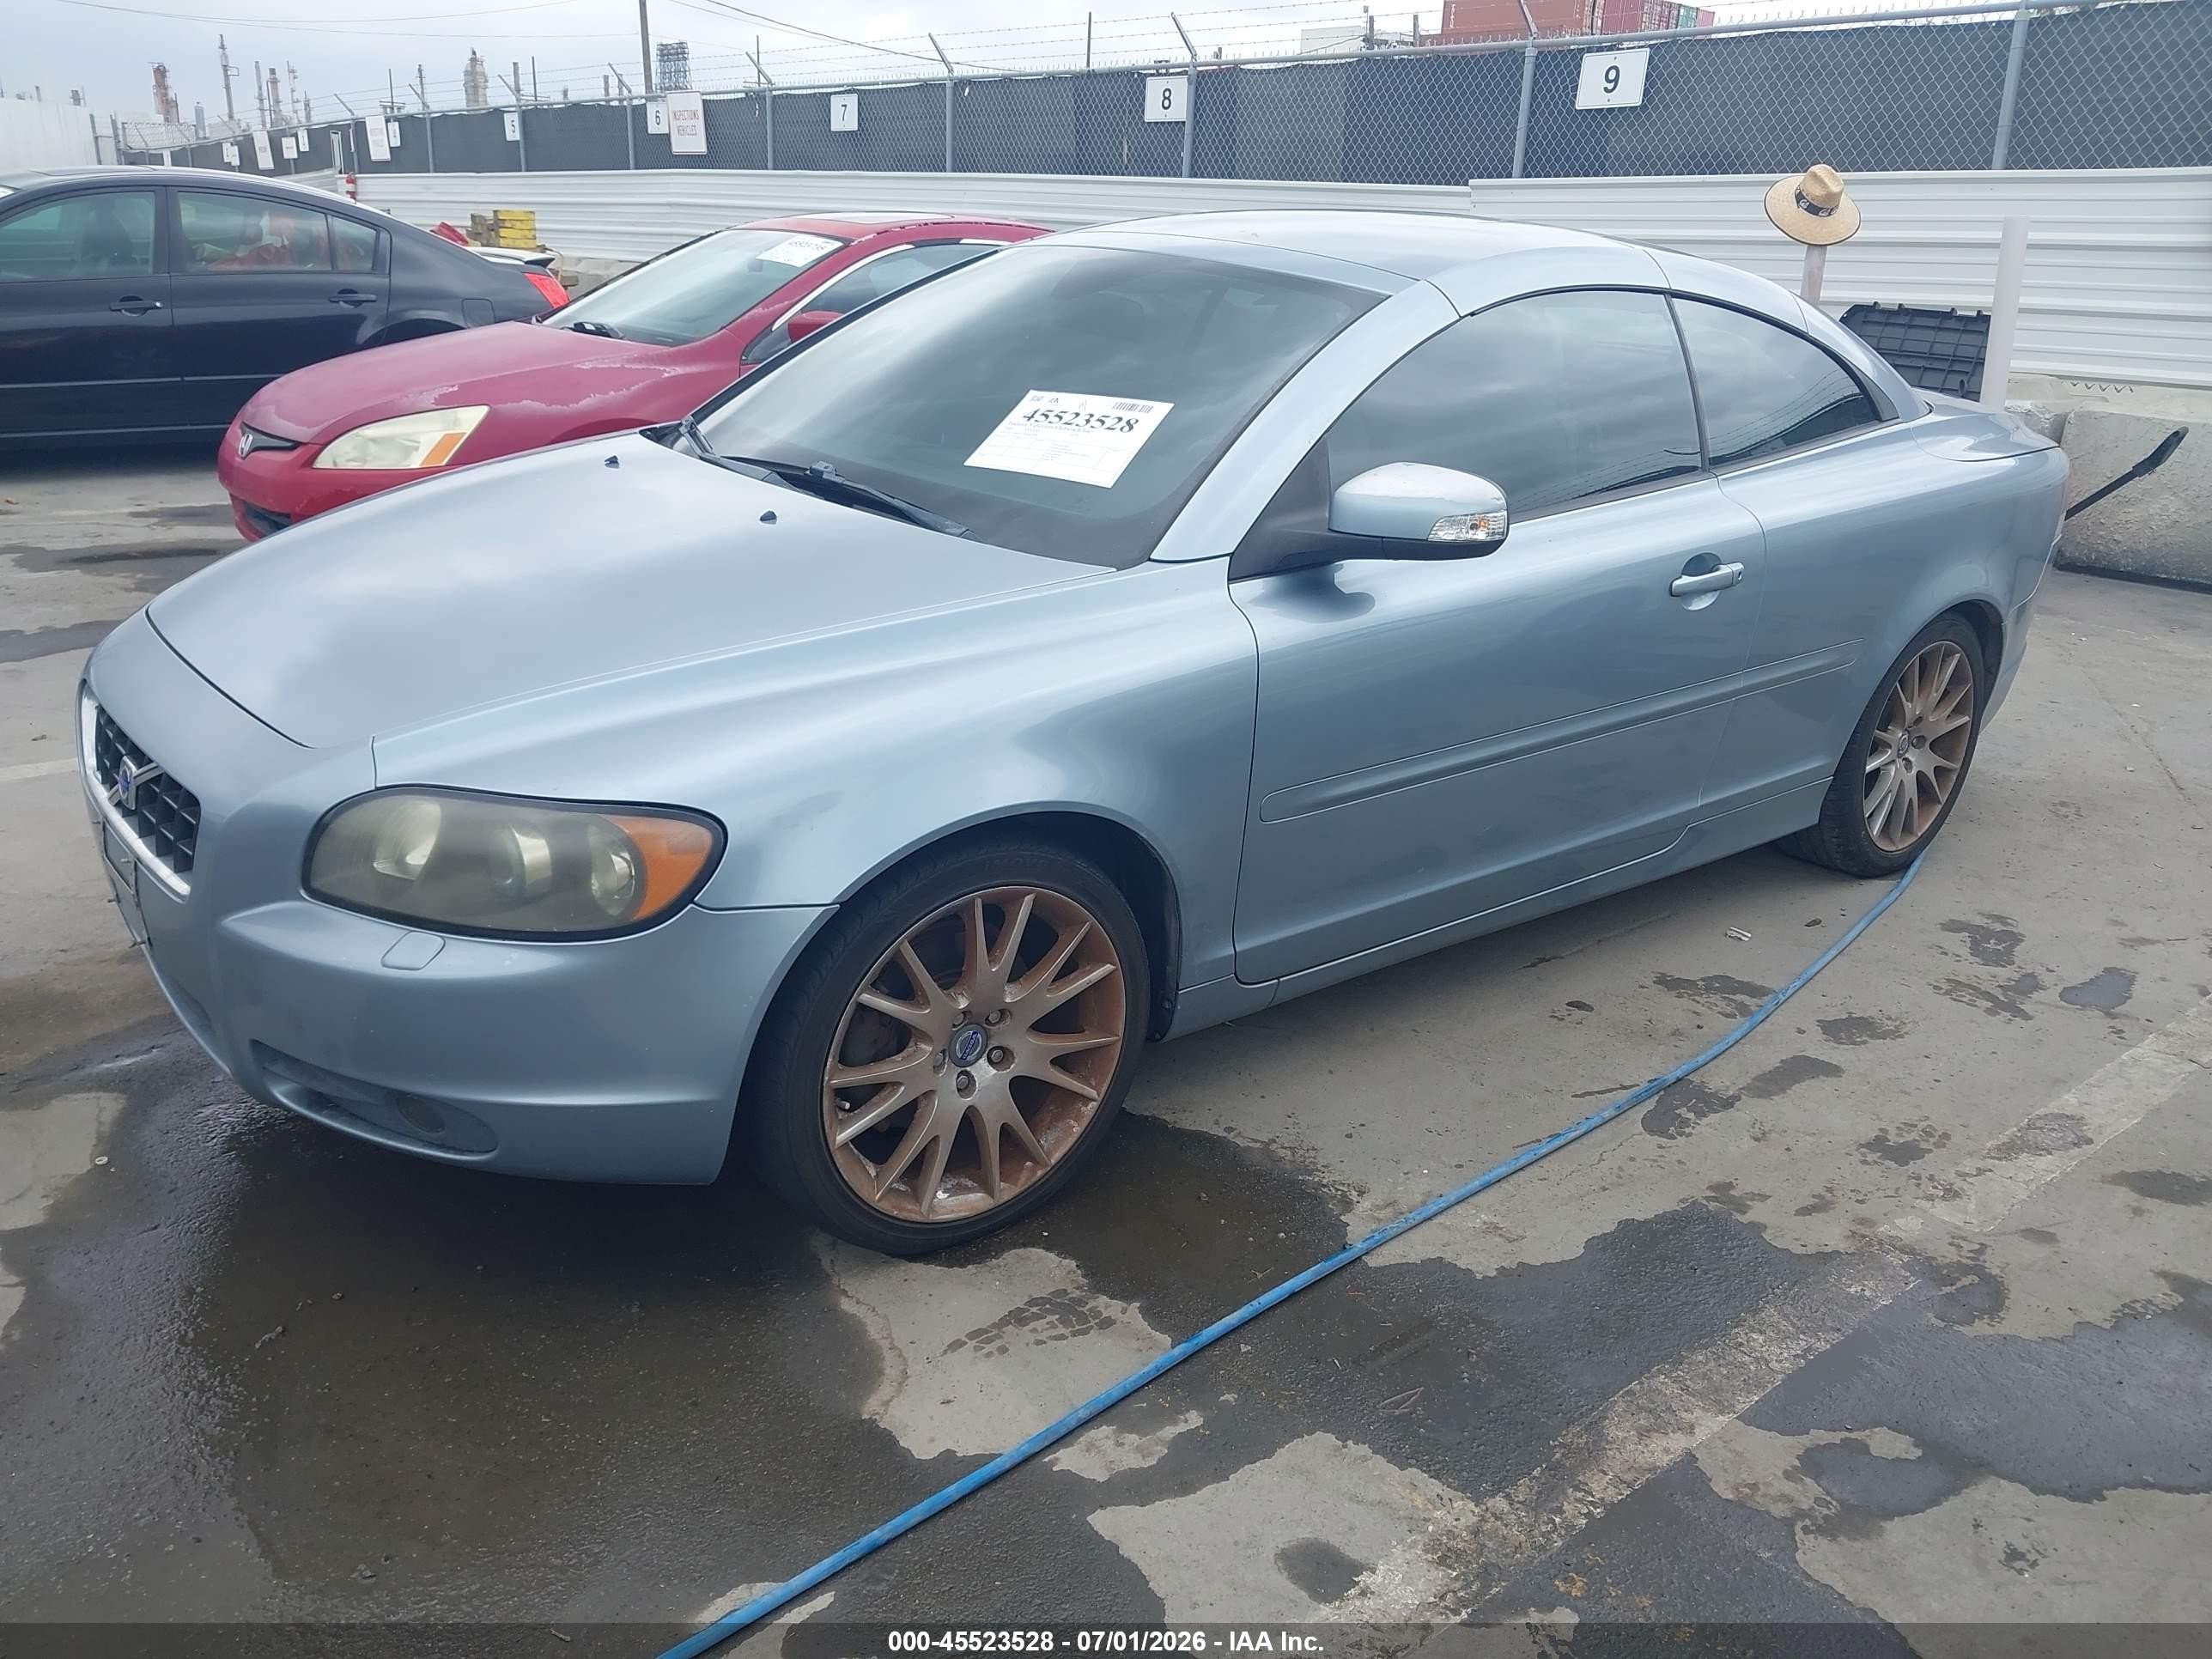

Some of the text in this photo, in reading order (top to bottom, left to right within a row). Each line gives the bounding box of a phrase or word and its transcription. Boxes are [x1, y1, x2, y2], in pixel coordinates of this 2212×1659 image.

[1603, 64, 1620, 94] 9
[1161, 88, 1172, 111] 8
[654, 110, 661, 126] 6
[841, 103, 848, 122] 7
[510, 119, 516, 134] 5
[1023, 408, 1139, 433] 45523528
